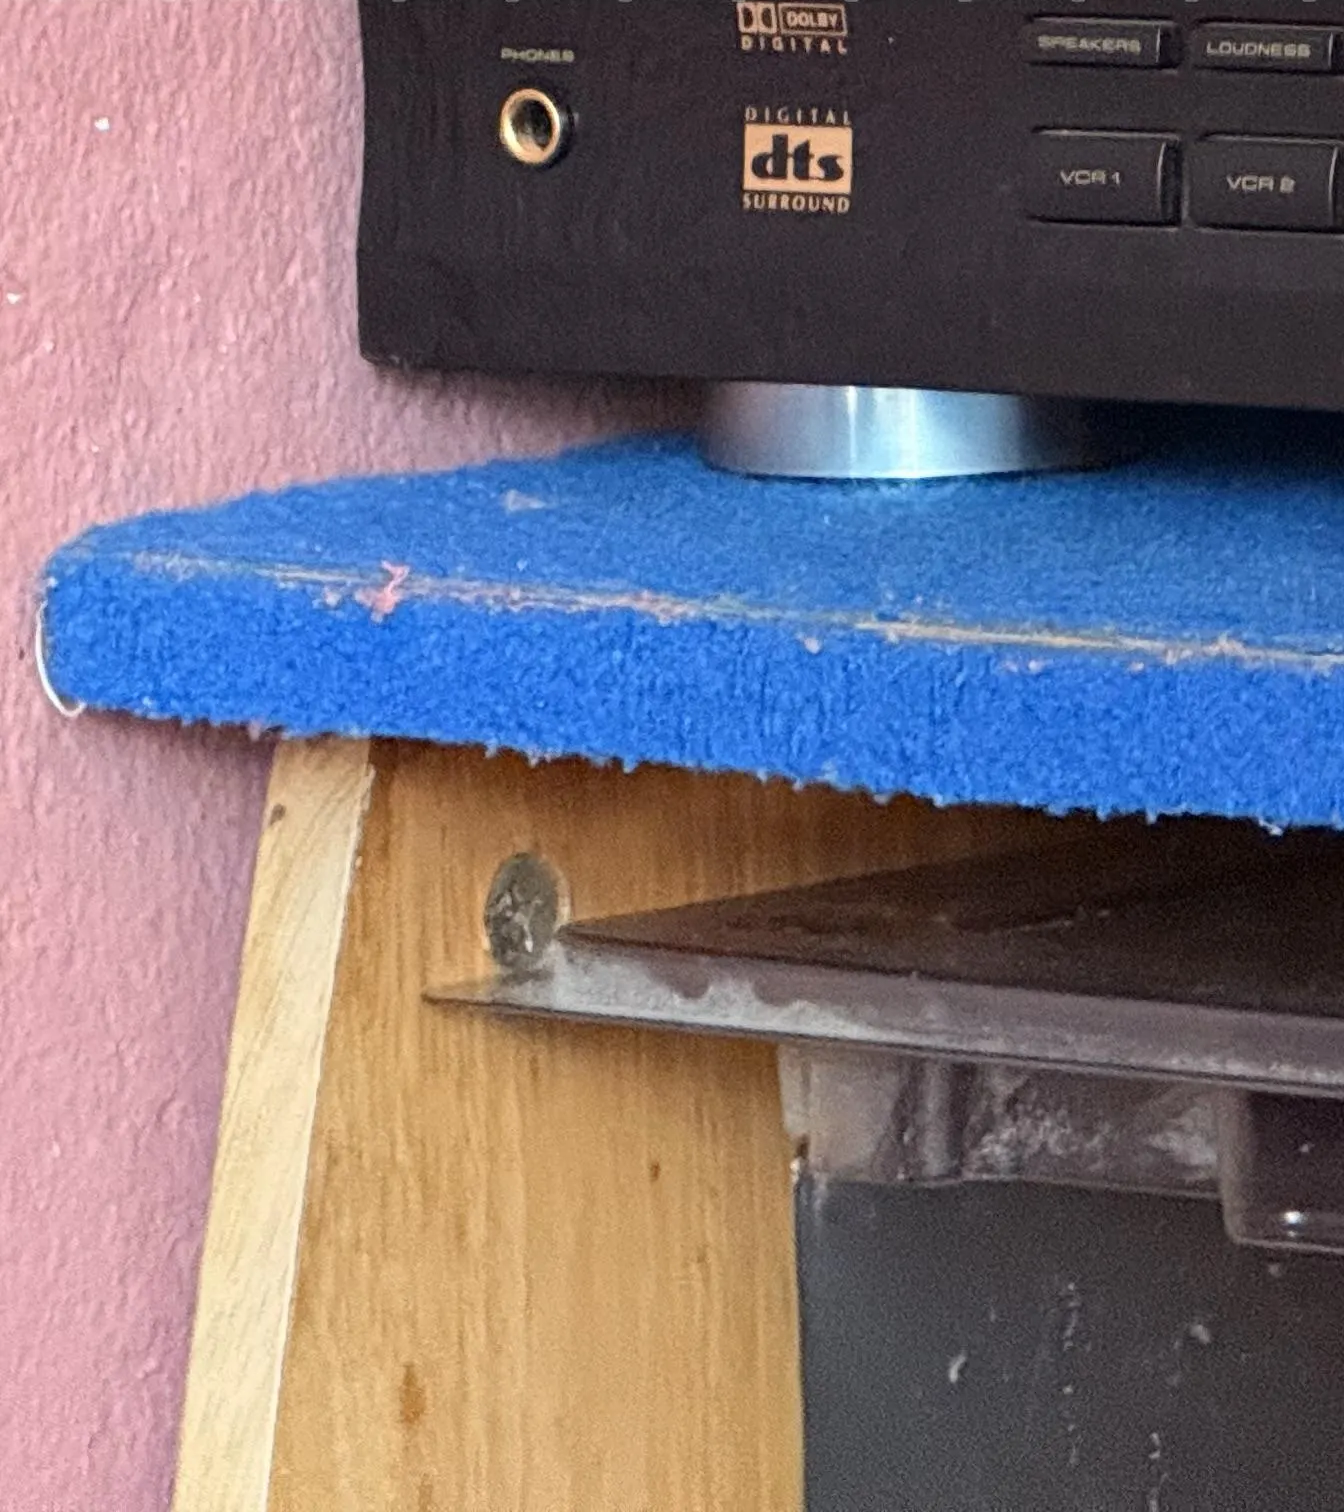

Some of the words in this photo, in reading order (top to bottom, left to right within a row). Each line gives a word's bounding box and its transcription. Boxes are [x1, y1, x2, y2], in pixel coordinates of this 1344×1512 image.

[786, 10, 838, 28] DOLBY
[740, 35, 848, 55] DIGITAL
[1037, 35, 1142, 54] SPEAKERS
[1206, 40, 1311, 58] LOUDNESS
[500, 47, 575, 63] PHONES
[744, 105, 851, 126] DIGITAL
[750, 133, 845, 183] dts
[1059, 169, 1107, 186] VCR
[1226, 175, 1275, 192] VCR
[742, 191, 851, 213] SURROUND
